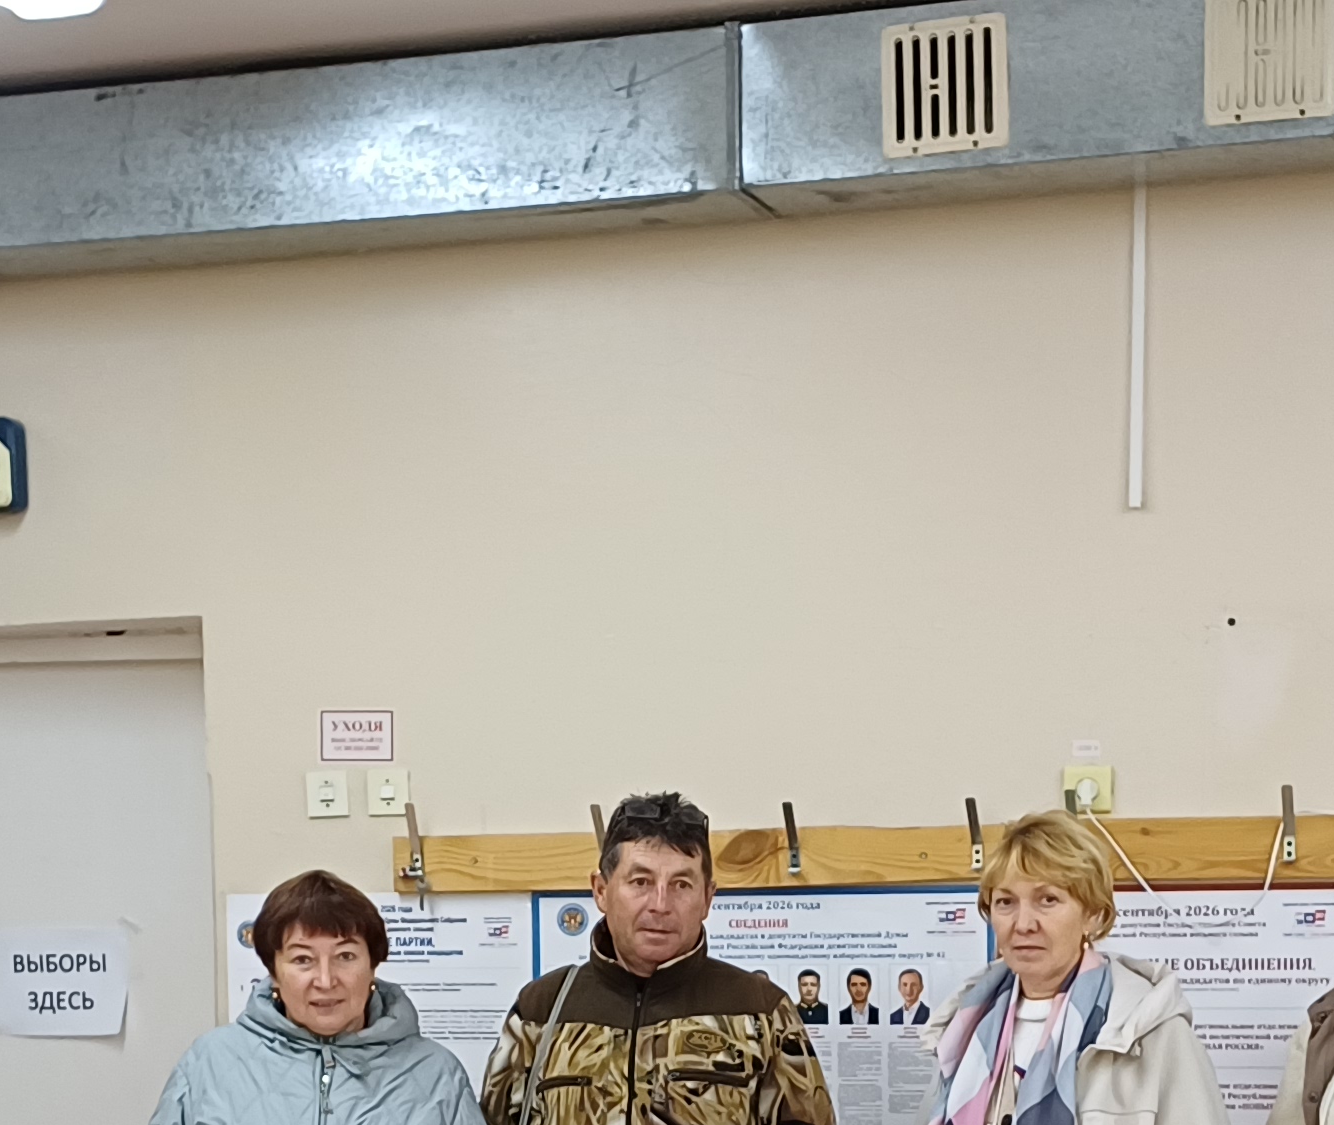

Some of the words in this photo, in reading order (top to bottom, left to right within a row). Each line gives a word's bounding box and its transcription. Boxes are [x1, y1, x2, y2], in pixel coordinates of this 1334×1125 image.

[331, 720, 383, 733] УХОДЯ
[712, 901, 763, 912] сентября
[766, 900, 793, 910] 2026
[796, 902, 821, 910] года
[1185, 905, 1219, 917] 2026
[13, 953, 107, 973] ВЫБОРЫ
[28, 990, 94, 1014] ЗДЕСЬ
